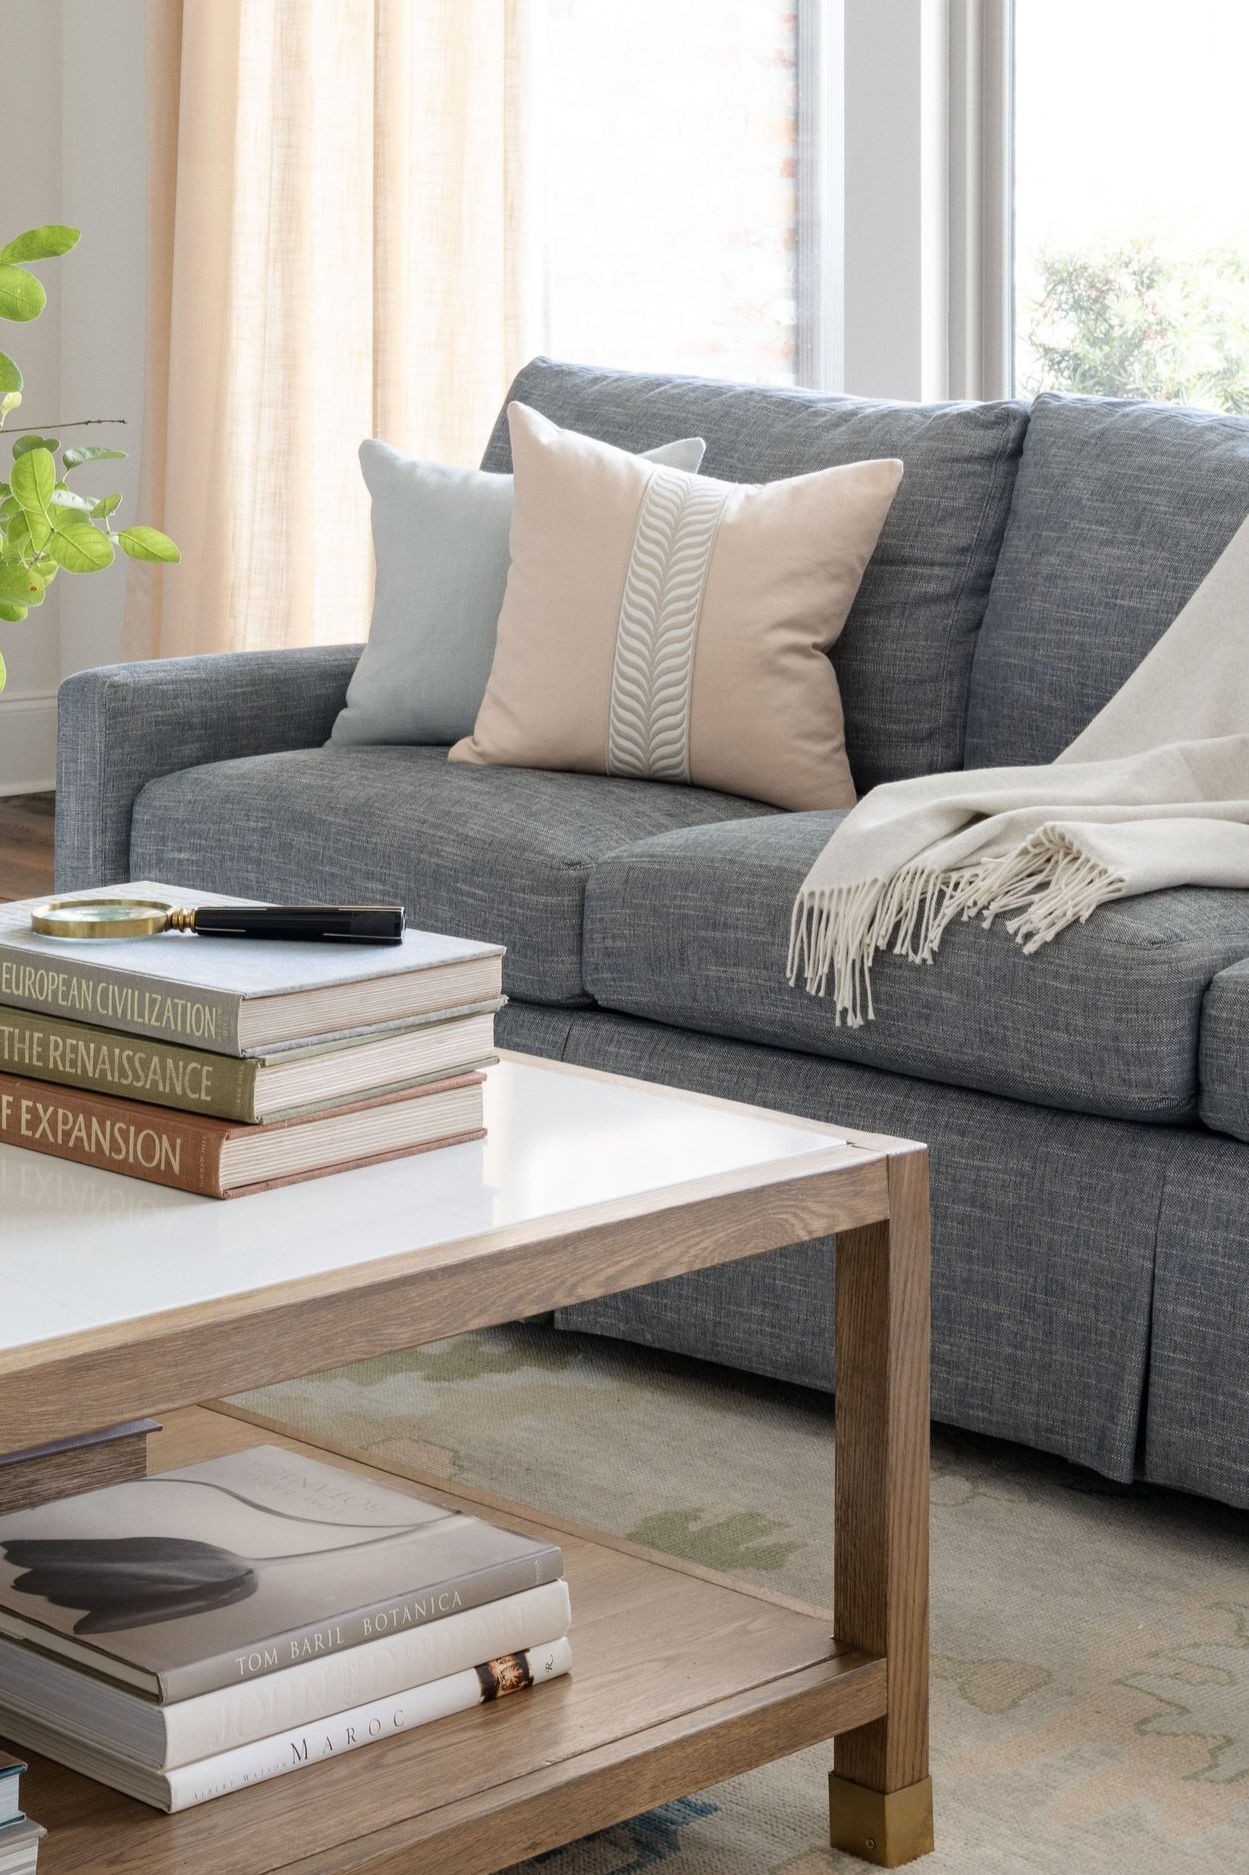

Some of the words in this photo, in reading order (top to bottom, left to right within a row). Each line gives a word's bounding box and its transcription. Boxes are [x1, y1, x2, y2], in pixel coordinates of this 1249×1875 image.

[2, 962, 93, 1012] EUROPEAN
[97, 982, 216, 1039] CIVILIZATION
[0, 1025, 43, 1066] THE
[49, 1035, 213, 1101] RENAISSANCE
[21, 1098, 182, 1175] EXPANSION
[235, 1647, 279, 1676] TOM
[290, 1626, 345, 1660] BARIL
[362, 1590, 463, 1637] BOTANICA
[192, 1780, 235, 1801] ALBERT
[242, 1762, 288, 1782] WATSON
[290, 1709, 406, 1765] MAROC
